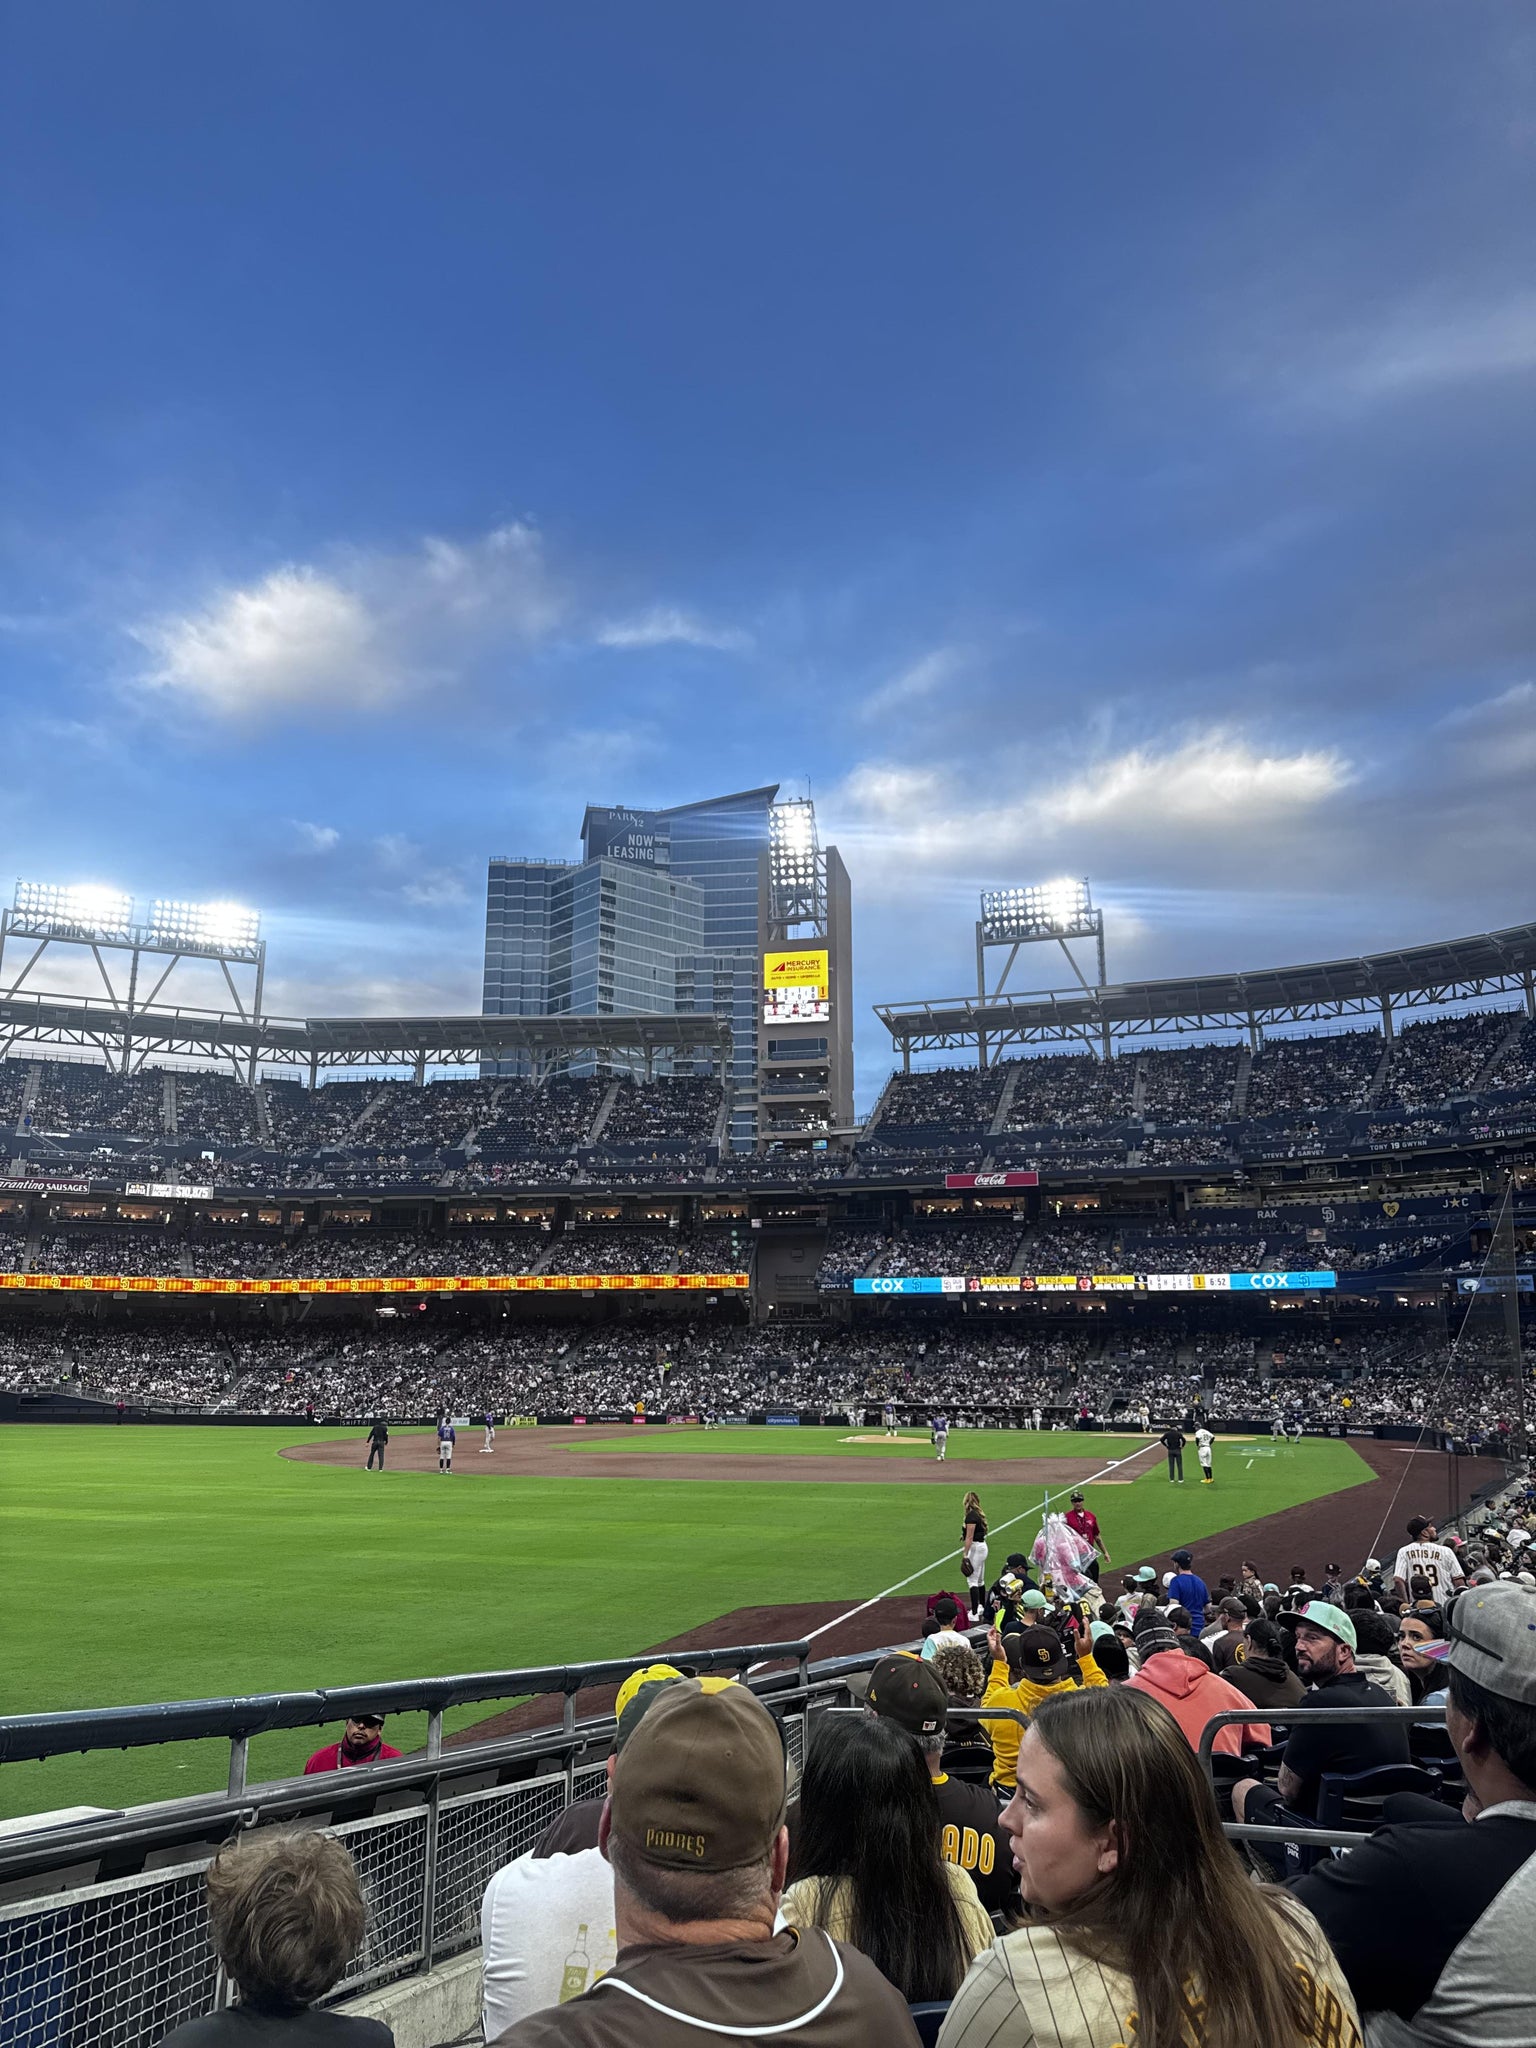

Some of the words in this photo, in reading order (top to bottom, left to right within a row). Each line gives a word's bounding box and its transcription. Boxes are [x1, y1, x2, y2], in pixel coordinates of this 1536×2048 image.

[628, 834, 654, 847] NOW
[607, 845, 654, 860] LEASING
[786, 959, 821, 967] MERCURY
[1474, 1132, 1493, 1140] DAVE
[1495, 1129, 1505, 1138] 31
[1402, 1140, 1427, 1148] GWYNN
[1495, 1151, 1536, 1164] JERR
[0, 1179, 45, 1190] arantino
[46, 1183, 88, 1192] SAUSAGES
[175, 1185, 209, 1198] $10,875
[1257, 1209, 1278, 1219] RAK
[871, 1278, 904, 1293] COX
[1209, 1278, 1226, 1286] 6:52
[1250, 1274, 1289, 1289] COX
[1406, 1549, 1429, 1560] TATIS
[646, 1828, 705, 1857] PADRES
